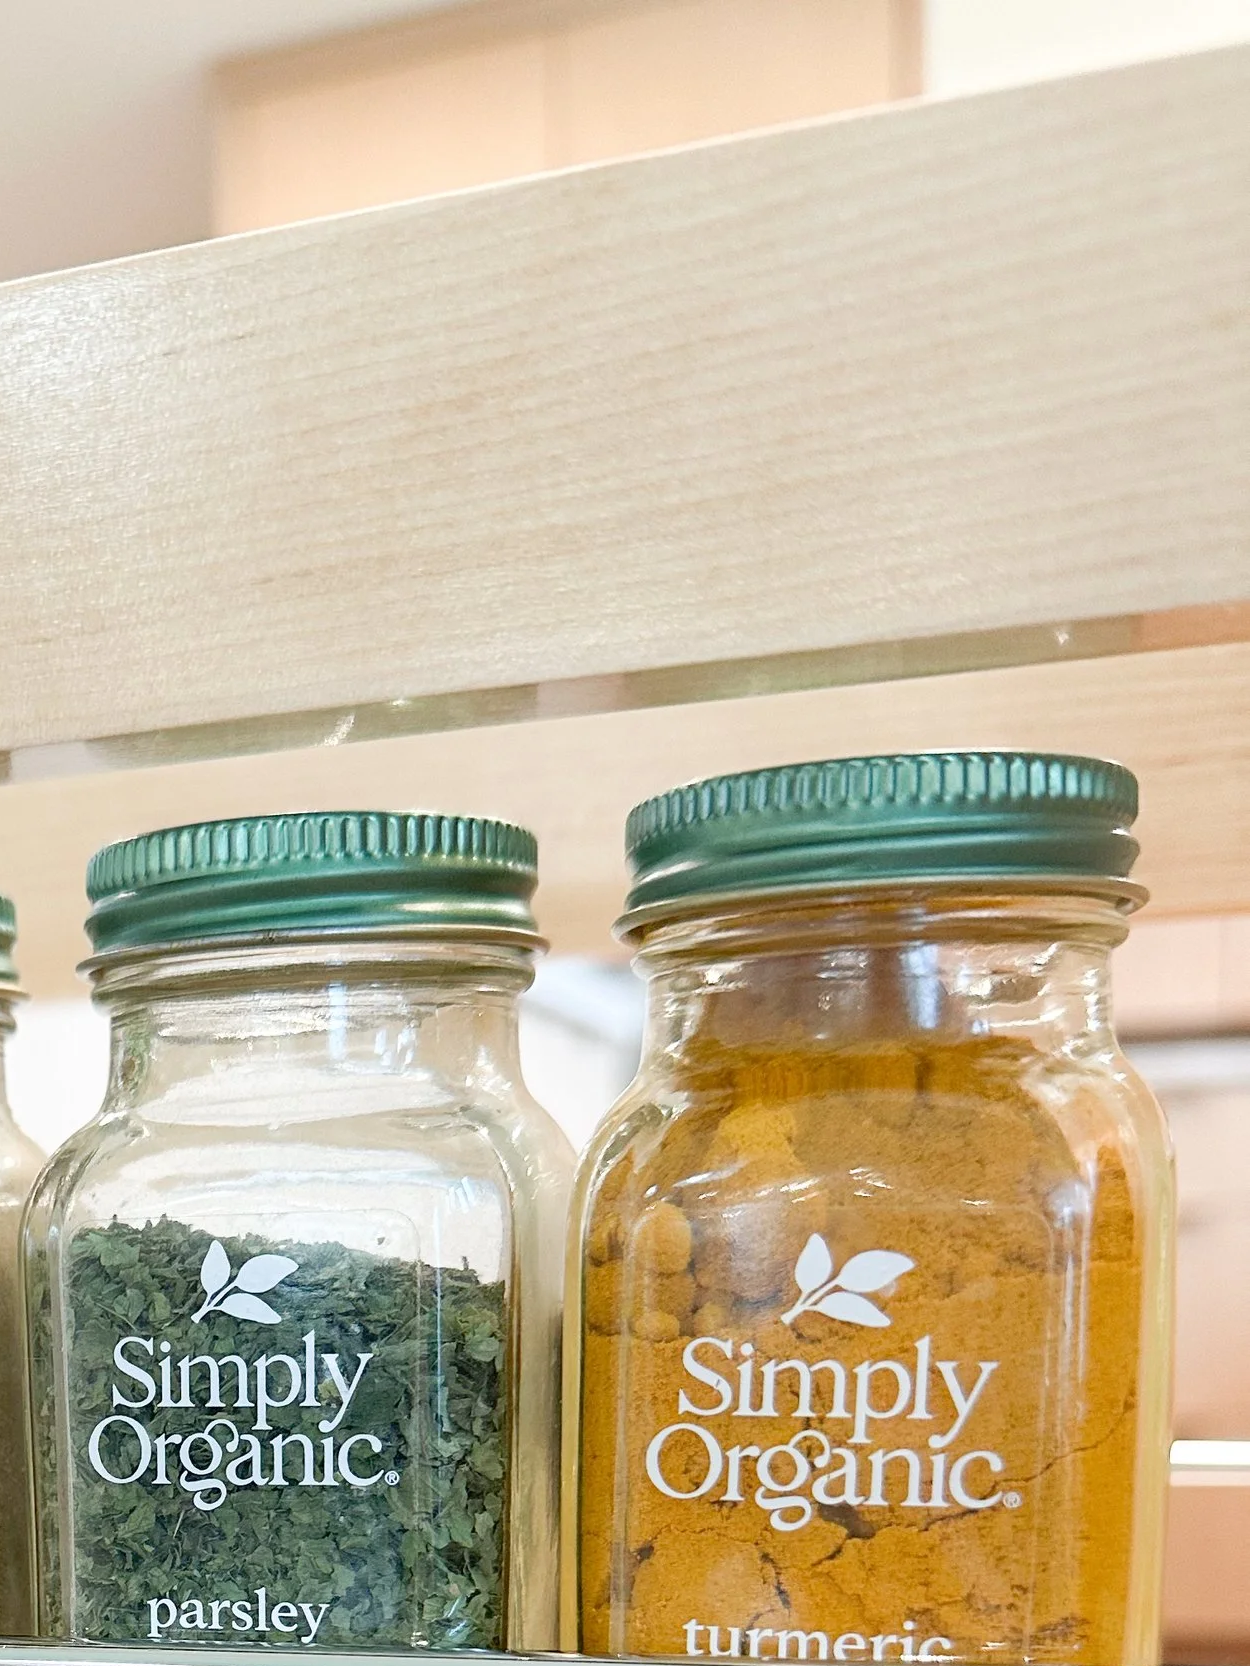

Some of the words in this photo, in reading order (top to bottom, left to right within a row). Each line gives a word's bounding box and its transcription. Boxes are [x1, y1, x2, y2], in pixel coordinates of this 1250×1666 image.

[111, 1328, 374, 1433] Simply
[677, 1334, 1001, 1449] Simply
[146, 1586, 330, 1644] parsley
[681, 1617, 956, 1661] turmeric
